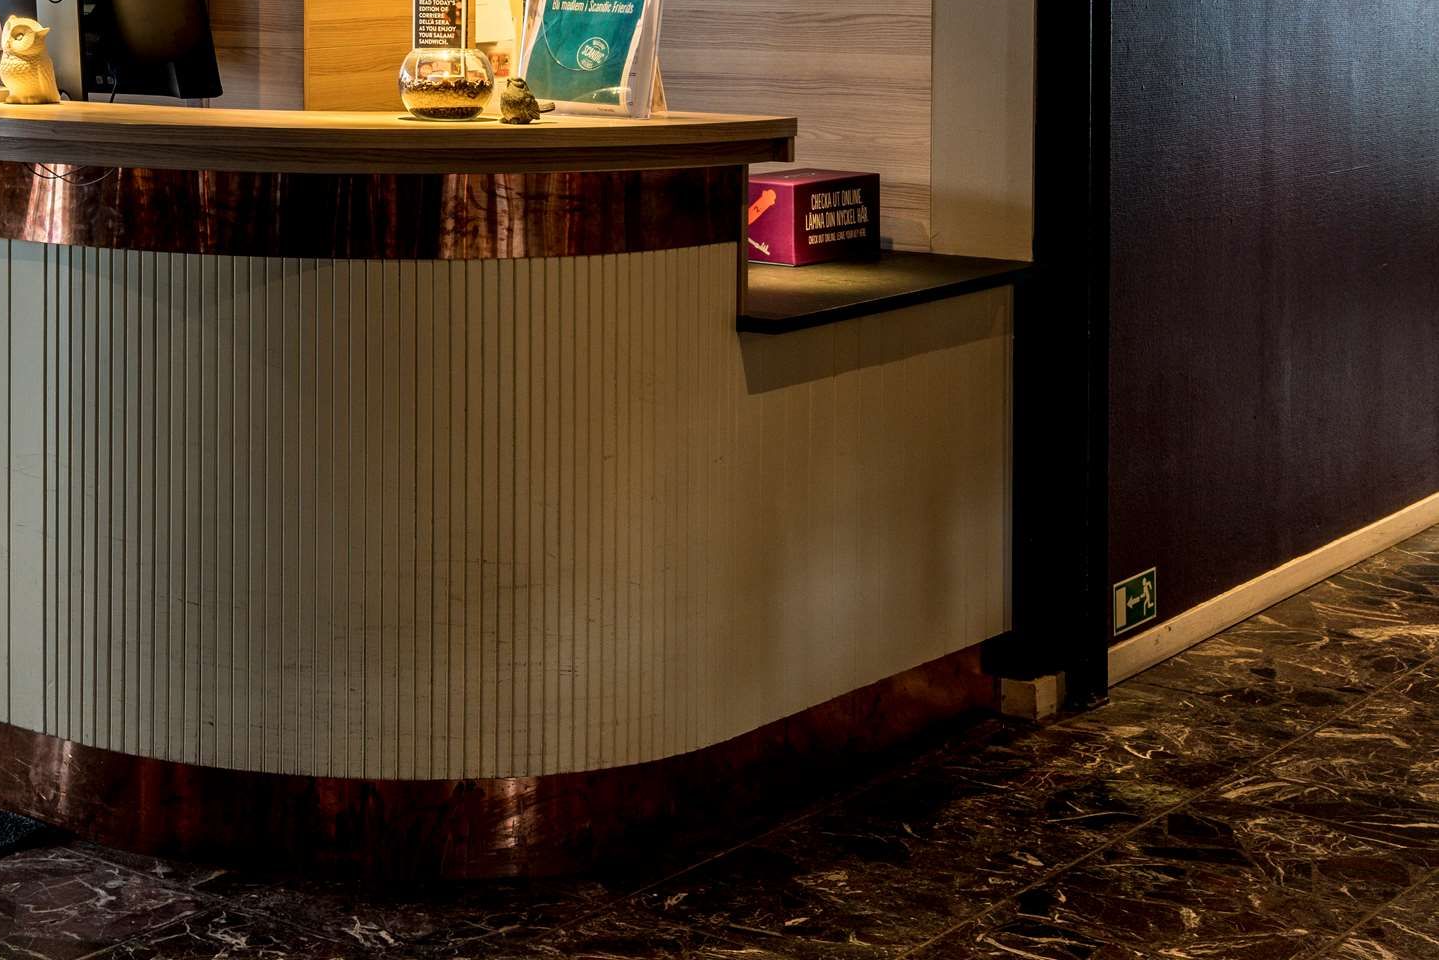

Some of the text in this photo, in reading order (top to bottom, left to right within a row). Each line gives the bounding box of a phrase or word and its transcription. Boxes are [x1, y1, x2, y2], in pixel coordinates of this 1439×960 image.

[589, 0, 611, 13] Scandic
[811, 193, 832, 210] CHECKA
[833, 191, 840, 207] UT
[805, 211, 825, 231] LÄMNA
[826, 211, 835, 228] DIN
[837, 208, 856, 226] NYCKEL
